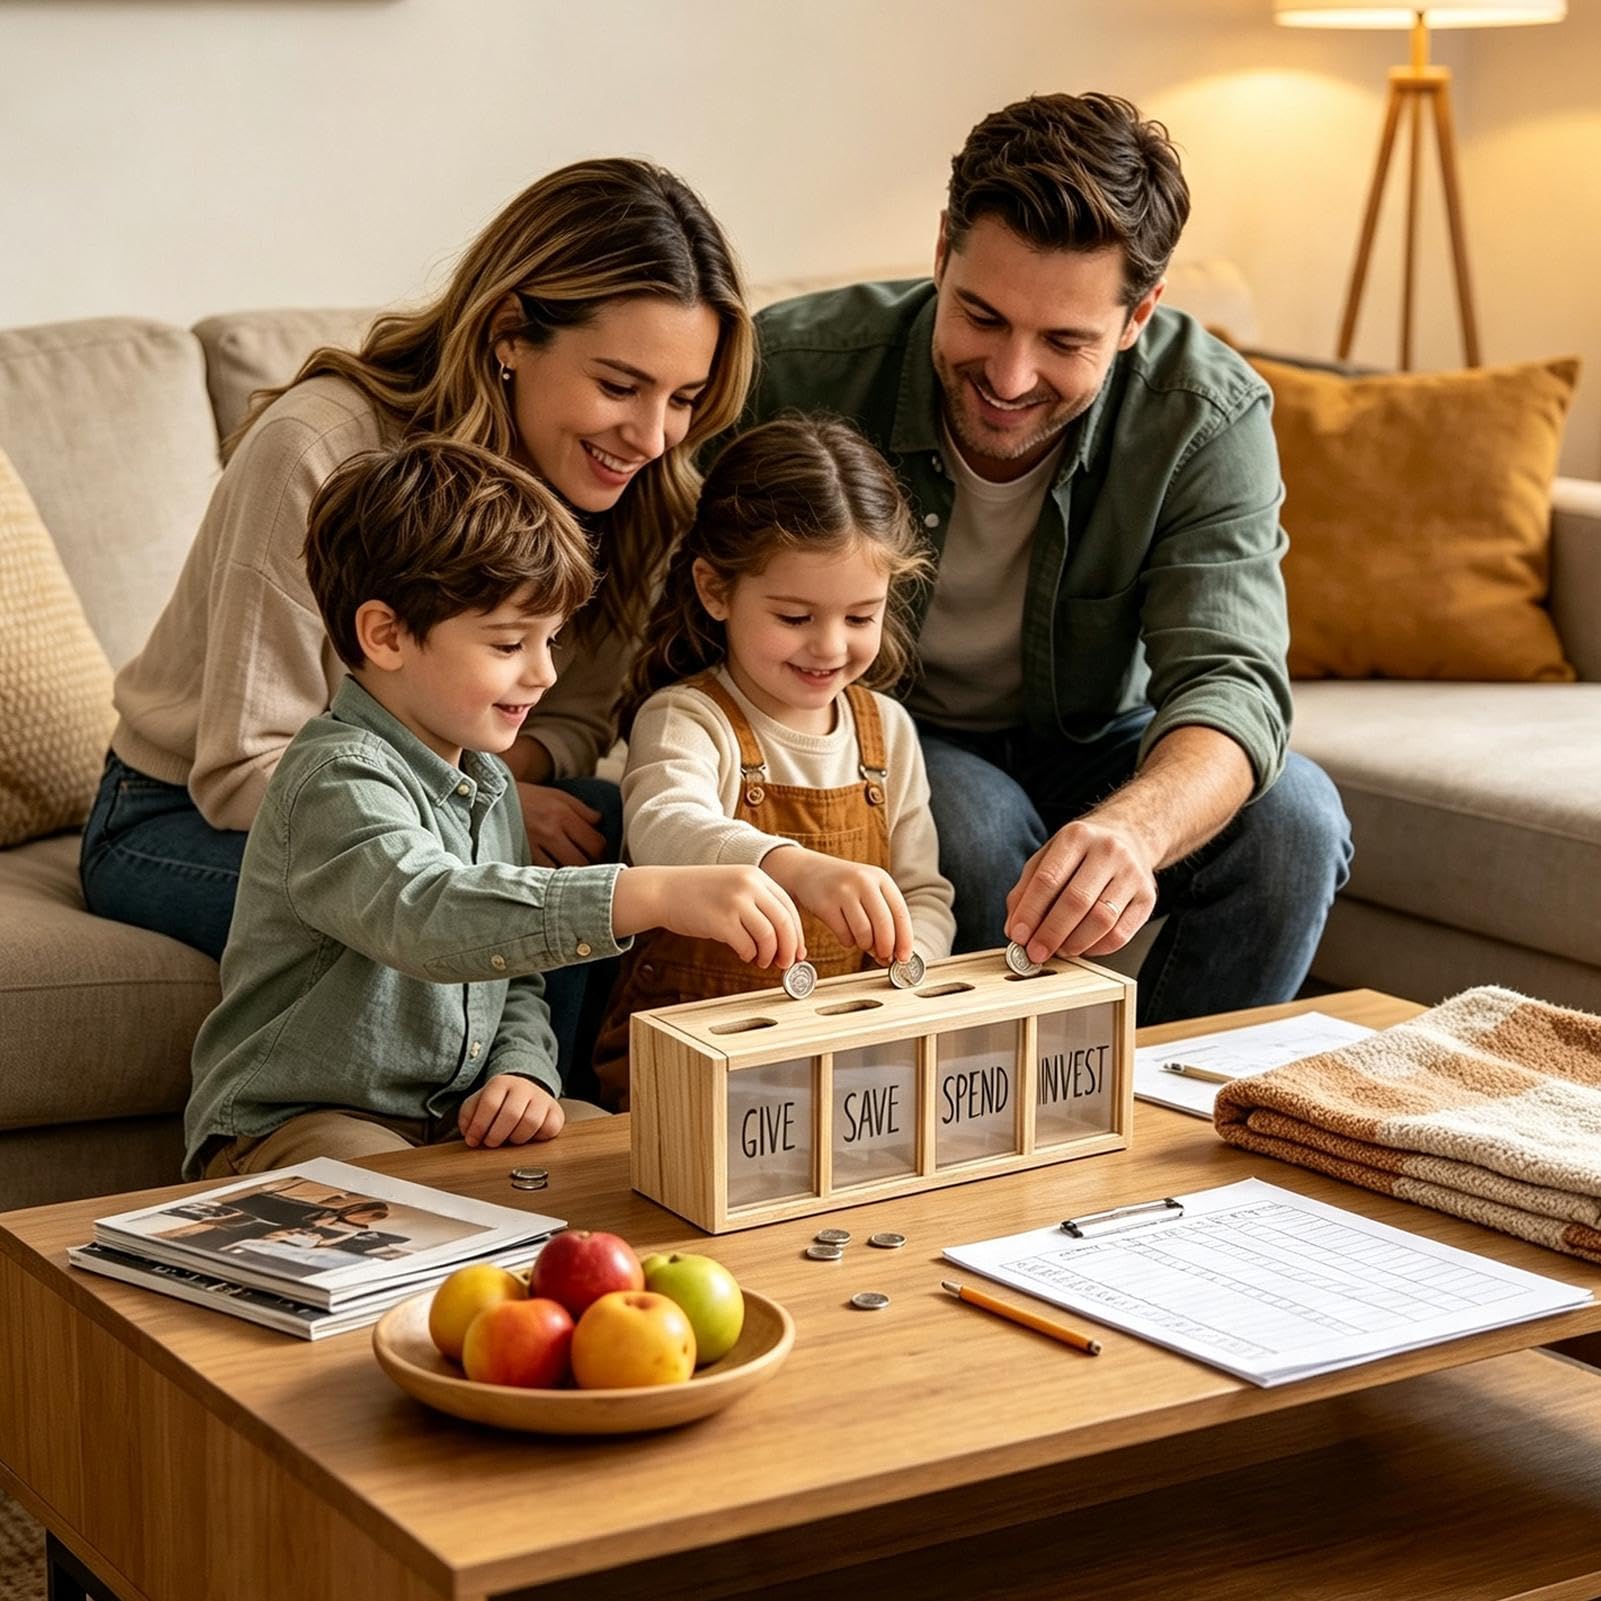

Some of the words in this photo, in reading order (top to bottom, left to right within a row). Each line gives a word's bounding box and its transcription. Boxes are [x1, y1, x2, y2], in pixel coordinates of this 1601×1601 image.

[941, 1066, 1009, 1125] SPEND
[1041, 1044, 1110, 1105] INVEST
[742, 1101, 796, 1159] GIVE
[843, 1084, 900, 1143] SAVE
